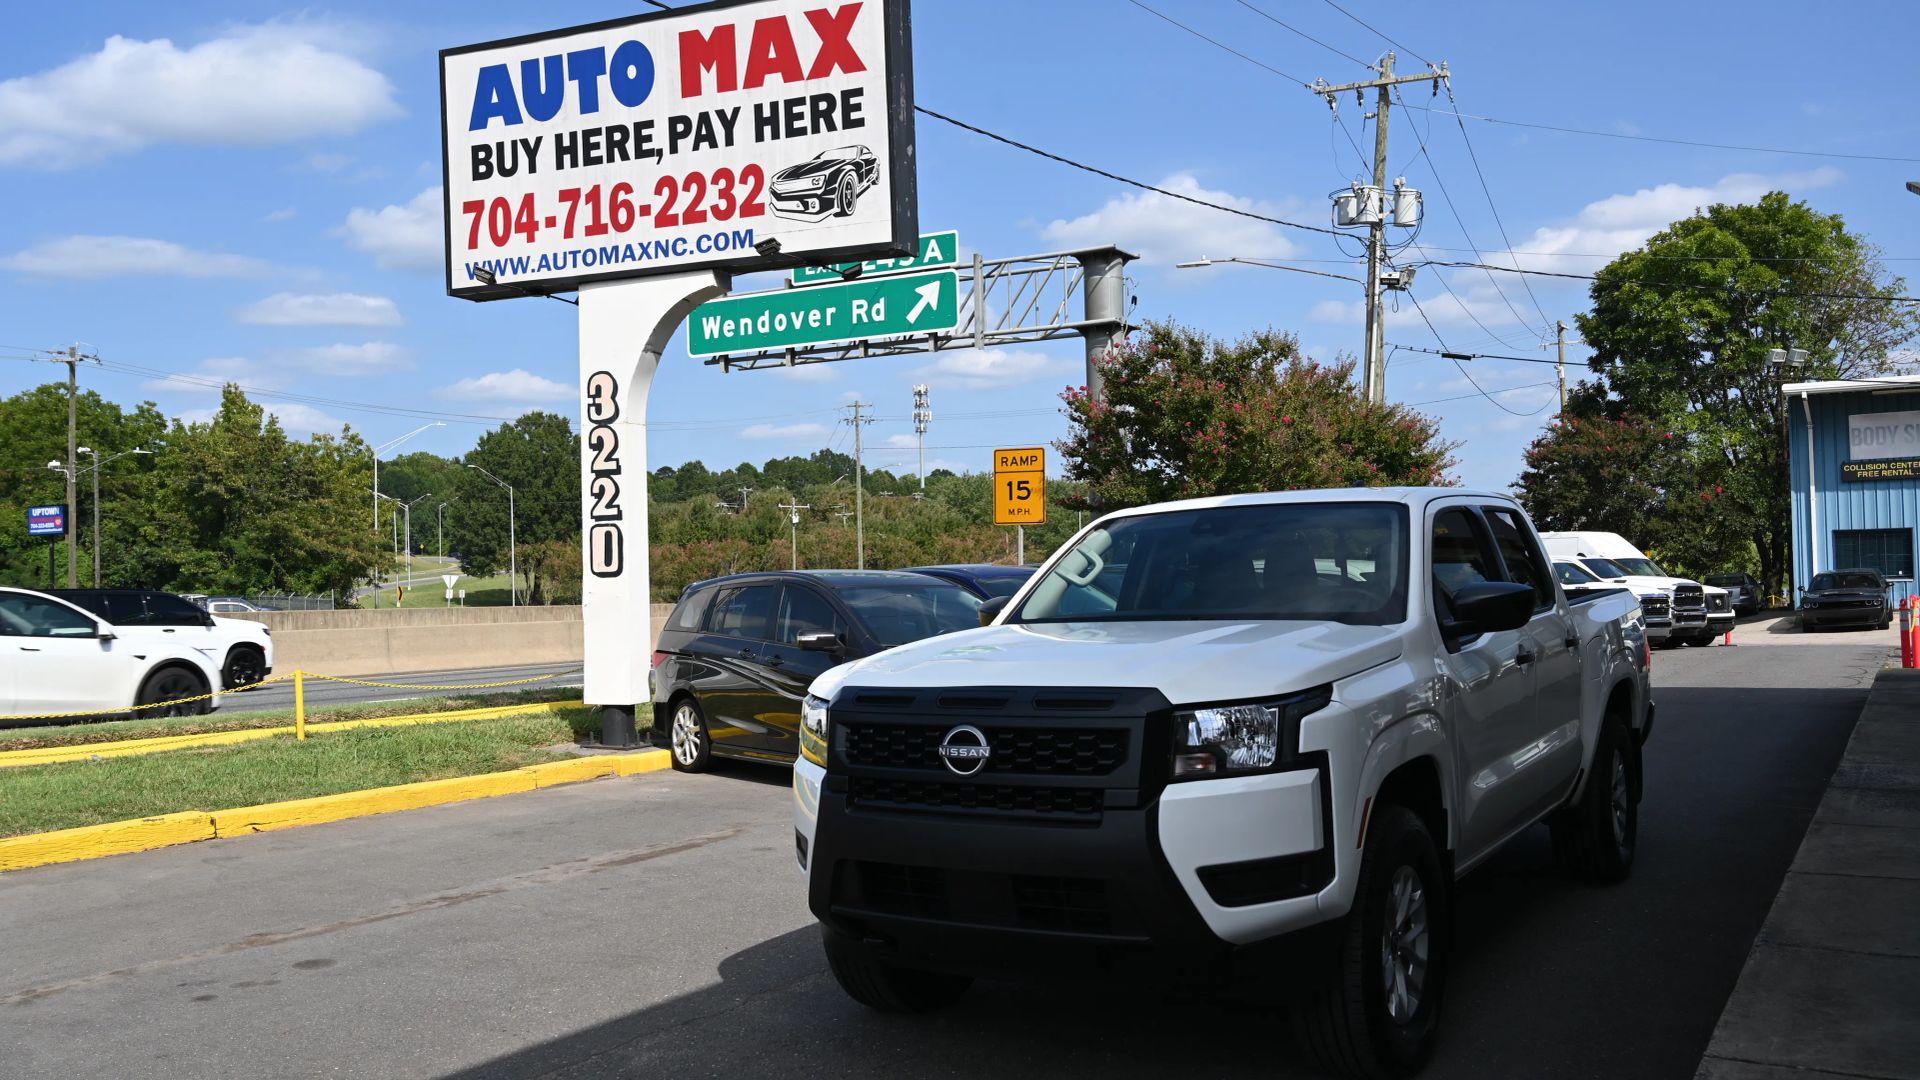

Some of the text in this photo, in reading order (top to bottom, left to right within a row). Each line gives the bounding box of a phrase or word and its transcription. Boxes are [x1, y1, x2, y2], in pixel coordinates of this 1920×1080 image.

[469, 1, 867, 131] AUTO MAX
[471, 136, 544, 182] BUY
[753, 87, 866, 143] HERE
[462, 163, 766, 250] 704-716-2232
[465, 229, 755, 281] WWW.AUTOMAXNC.COM
[923, 239, 943, 263] A
[702, 297, 886, 340] Wendover Rd
[1851, 425, 1899, 446] BODY
[1001, 455, 1038, 466] RAMP
[1843, 463, 1888, 471] COLLISION
[587, 370, 624, 578] 3220
[1007, 480, 1031, 501] 15
[32, 507, 60, 516] UPTOWN
[939, 747, 990, 757] NISSAN
